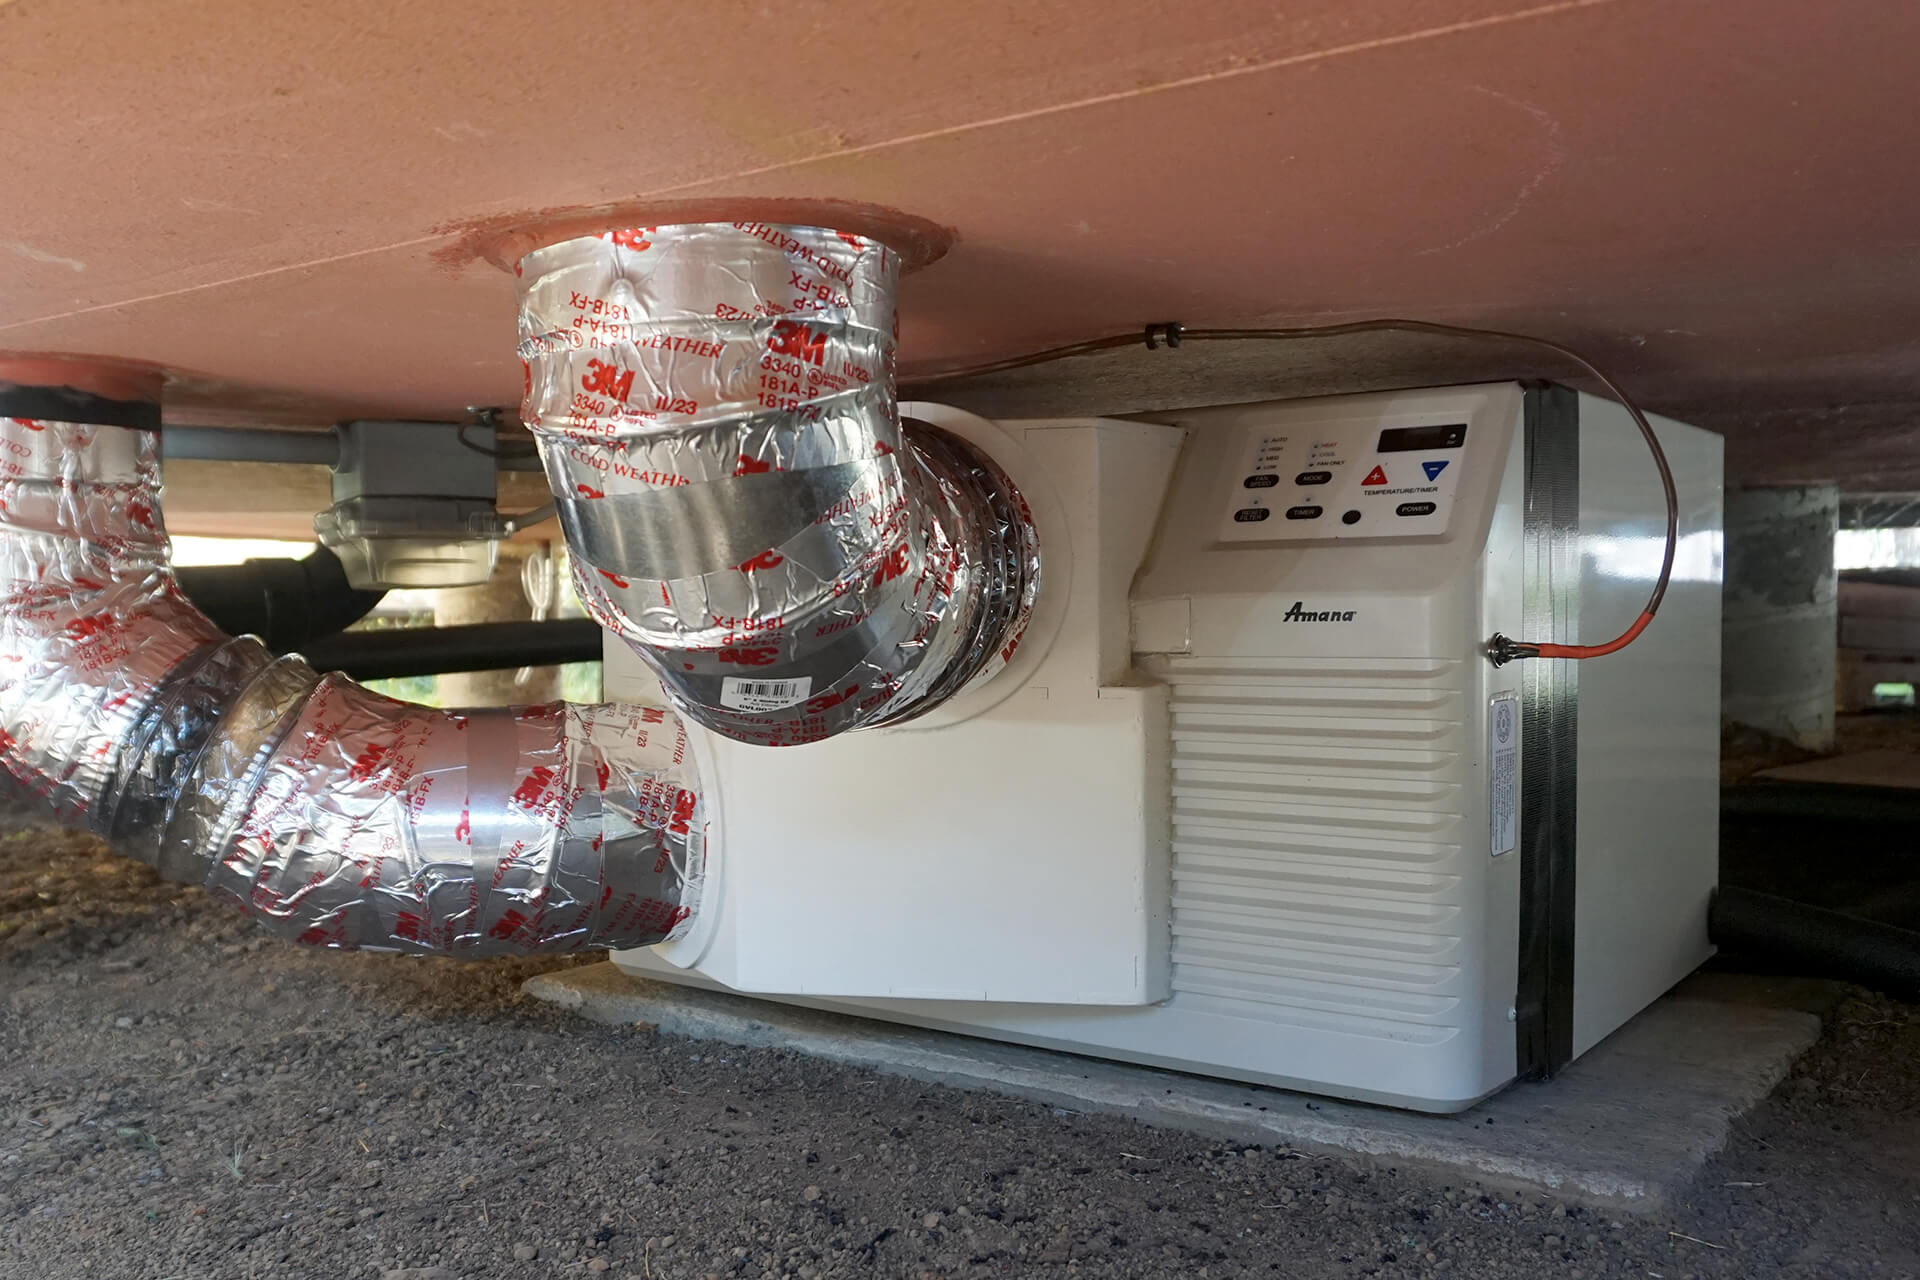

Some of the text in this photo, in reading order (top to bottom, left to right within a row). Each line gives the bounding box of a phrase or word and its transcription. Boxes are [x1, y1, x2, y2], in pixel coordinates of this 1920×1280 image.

[569, 291, 628, 320] 181B-FX
[573, 315, 627, 339] 181A-P
[768, 320, 828, 366] 3M
[582, 358, 635, 402] 3M
[761, 356, 800, 378] 3340
[760, 374, 819, 398] 181A-P
[573, 393, 606, 415] 3340
[757, 391, 822, 421] 181B-FX
[569, 411, 616, 438] 181A-P
[570, 447, 609, 470] COLD
[1364, 486, 1438, 496] TEMPERATURE/TIMER
[872, 543, 909, 588] 3M
[712, 615, 784, 632] 181B-FX
[1283, 602, 1354, 623] Amana
[515, 766, 554, 809] 3M
[650, 780, 664, 822] 181A-P
[662, 784, 676, 812] 3340
[669, 789, 696, 835] 3M
